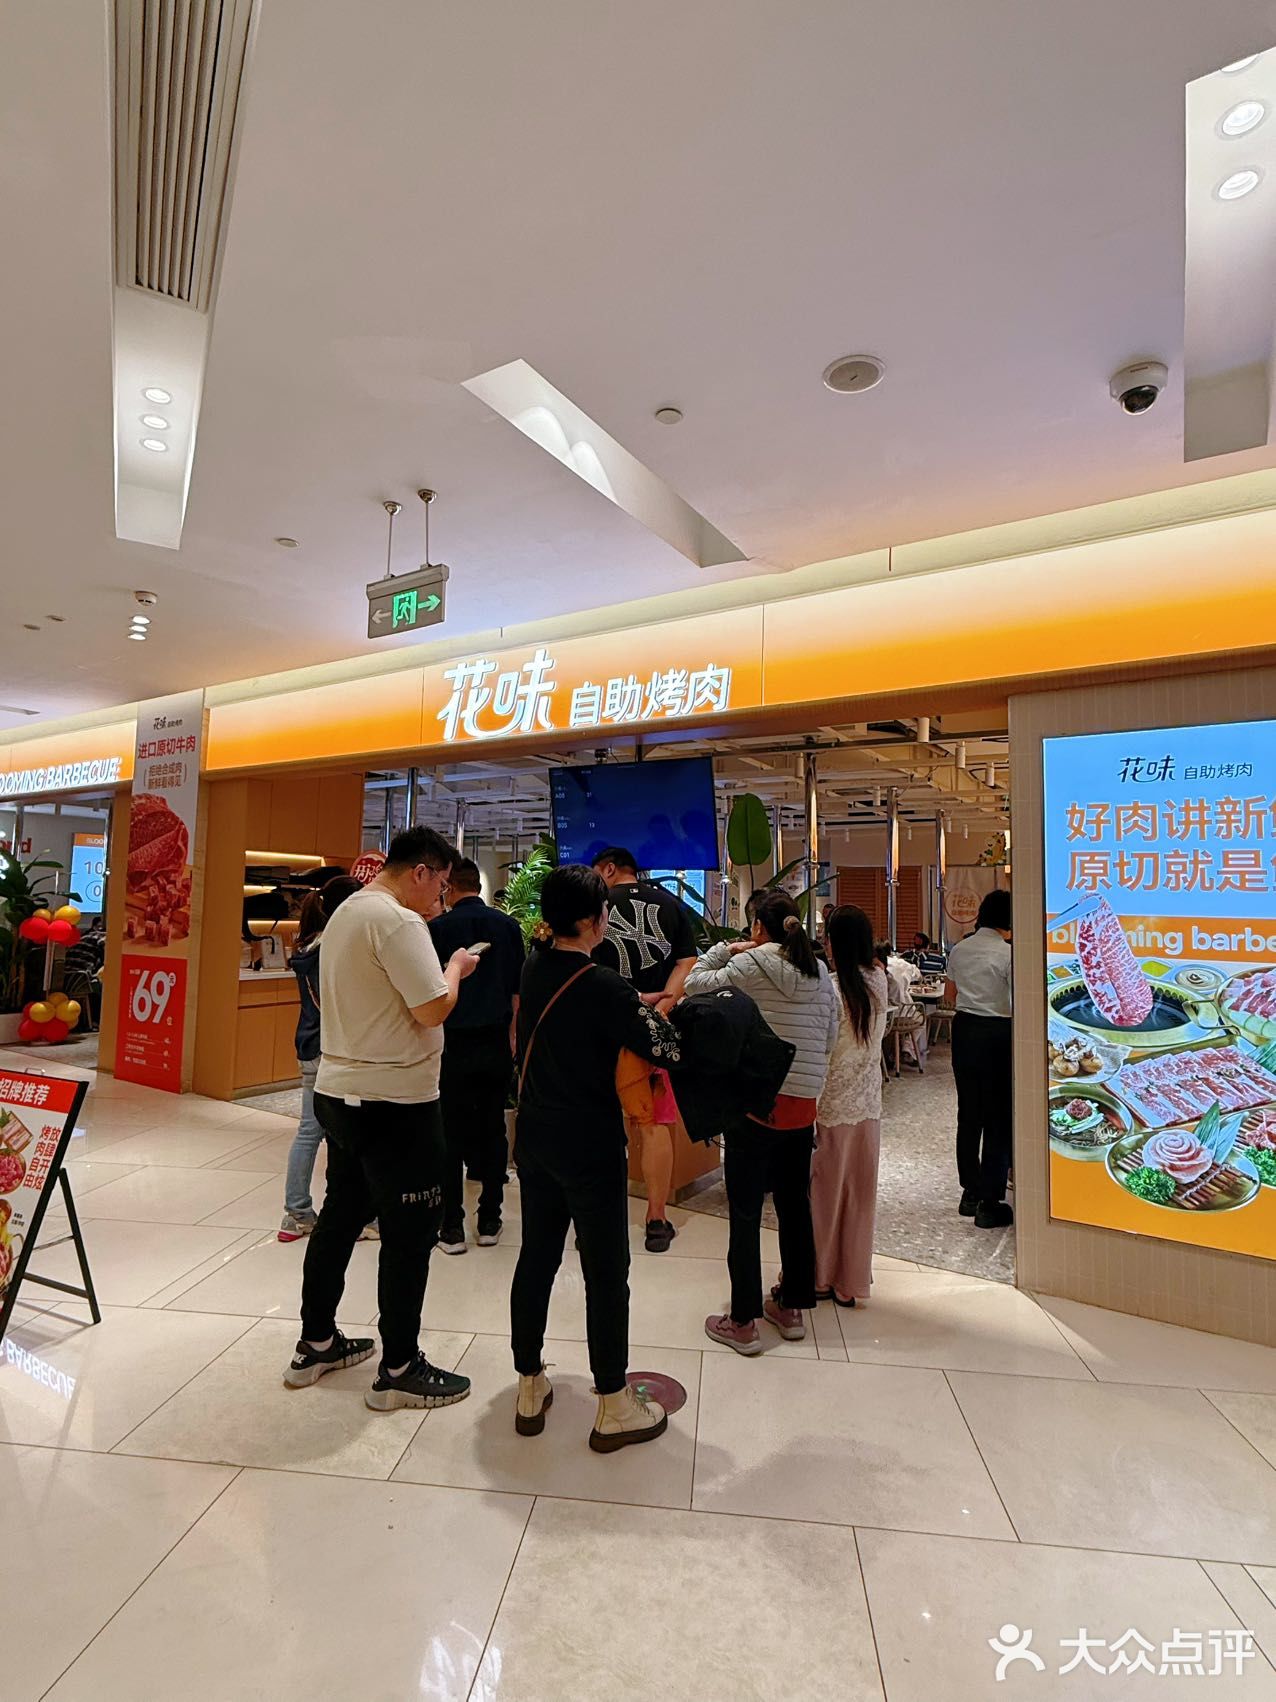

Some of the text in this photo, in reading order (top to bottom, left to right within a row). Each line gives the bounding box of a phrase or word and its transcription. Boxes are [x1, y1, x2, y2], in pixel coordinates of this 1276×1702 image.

[437, 648, 732, 741] 花味 自助烤肉
[137, 734, 196, 760] 进口原切牛肉
[46, 757, 121, 790] BARBECUE
[1117, 755, 1253, 783] 花味 自助烤肉
[1065, 795, 1276, 842] 好肉讲新
[1066, 849, 1276, 892] 原切就是
[132, 970, 171, 1024] 69
[0, 1078, 51, 1106] 招牌推荐
[23, 1124, 52, 1188] 烤肉自由
